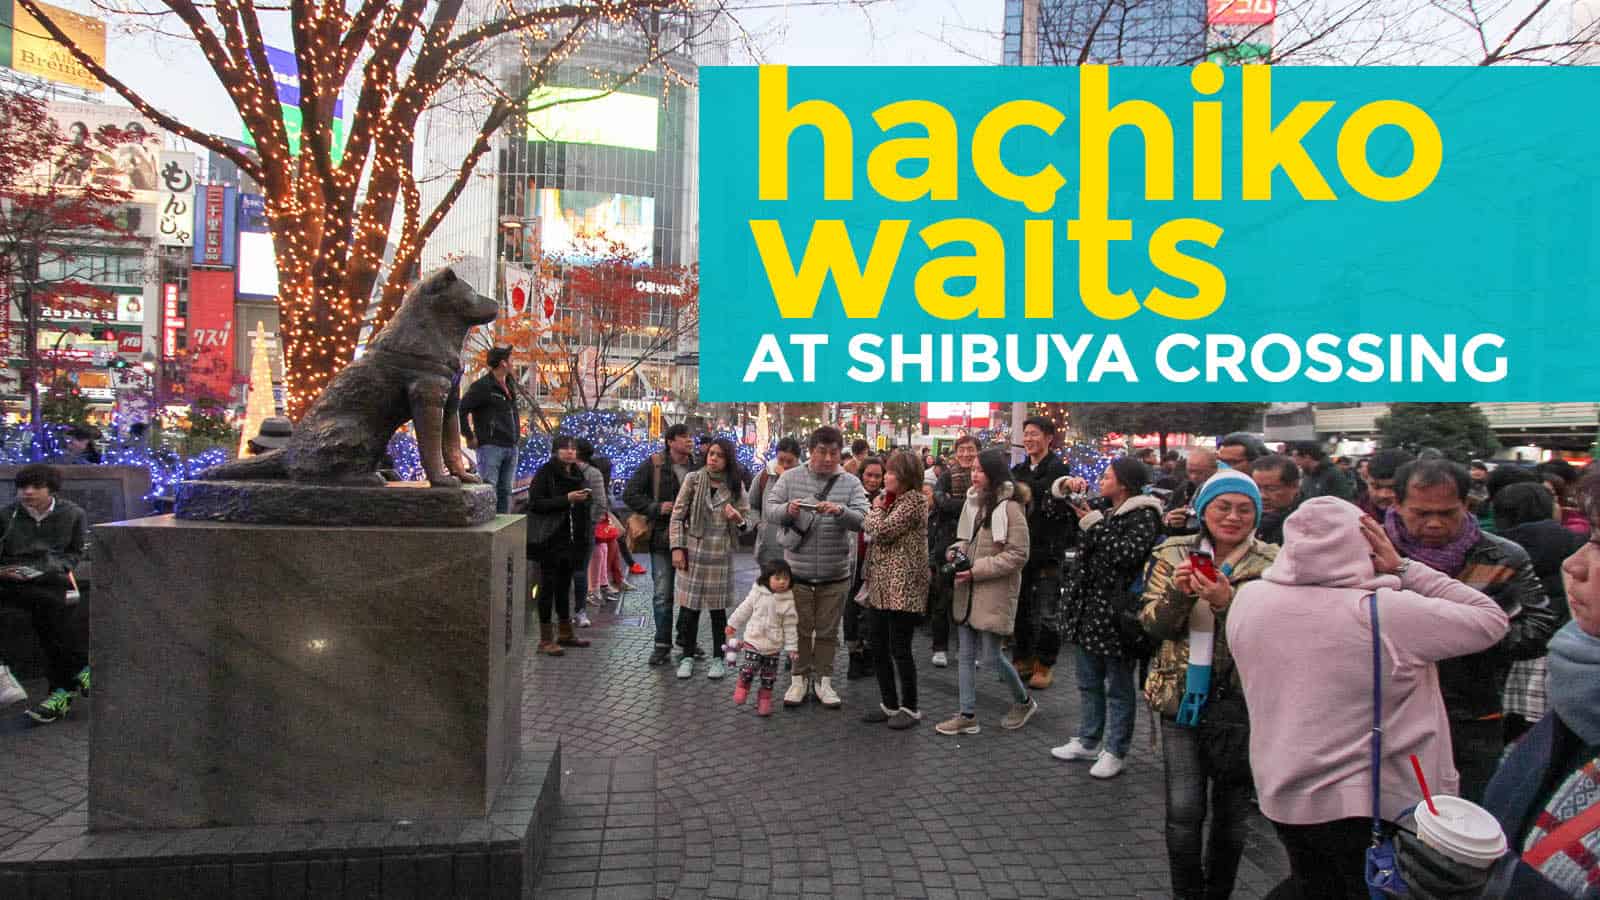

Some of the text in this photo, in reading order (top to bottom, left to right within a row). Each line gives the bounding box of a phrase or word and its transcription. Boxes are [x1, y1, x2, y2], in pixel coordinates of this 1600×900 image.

[160, 160, 192, 243] もんじゃ
[619, 399, 676, 412] TSUTYA
